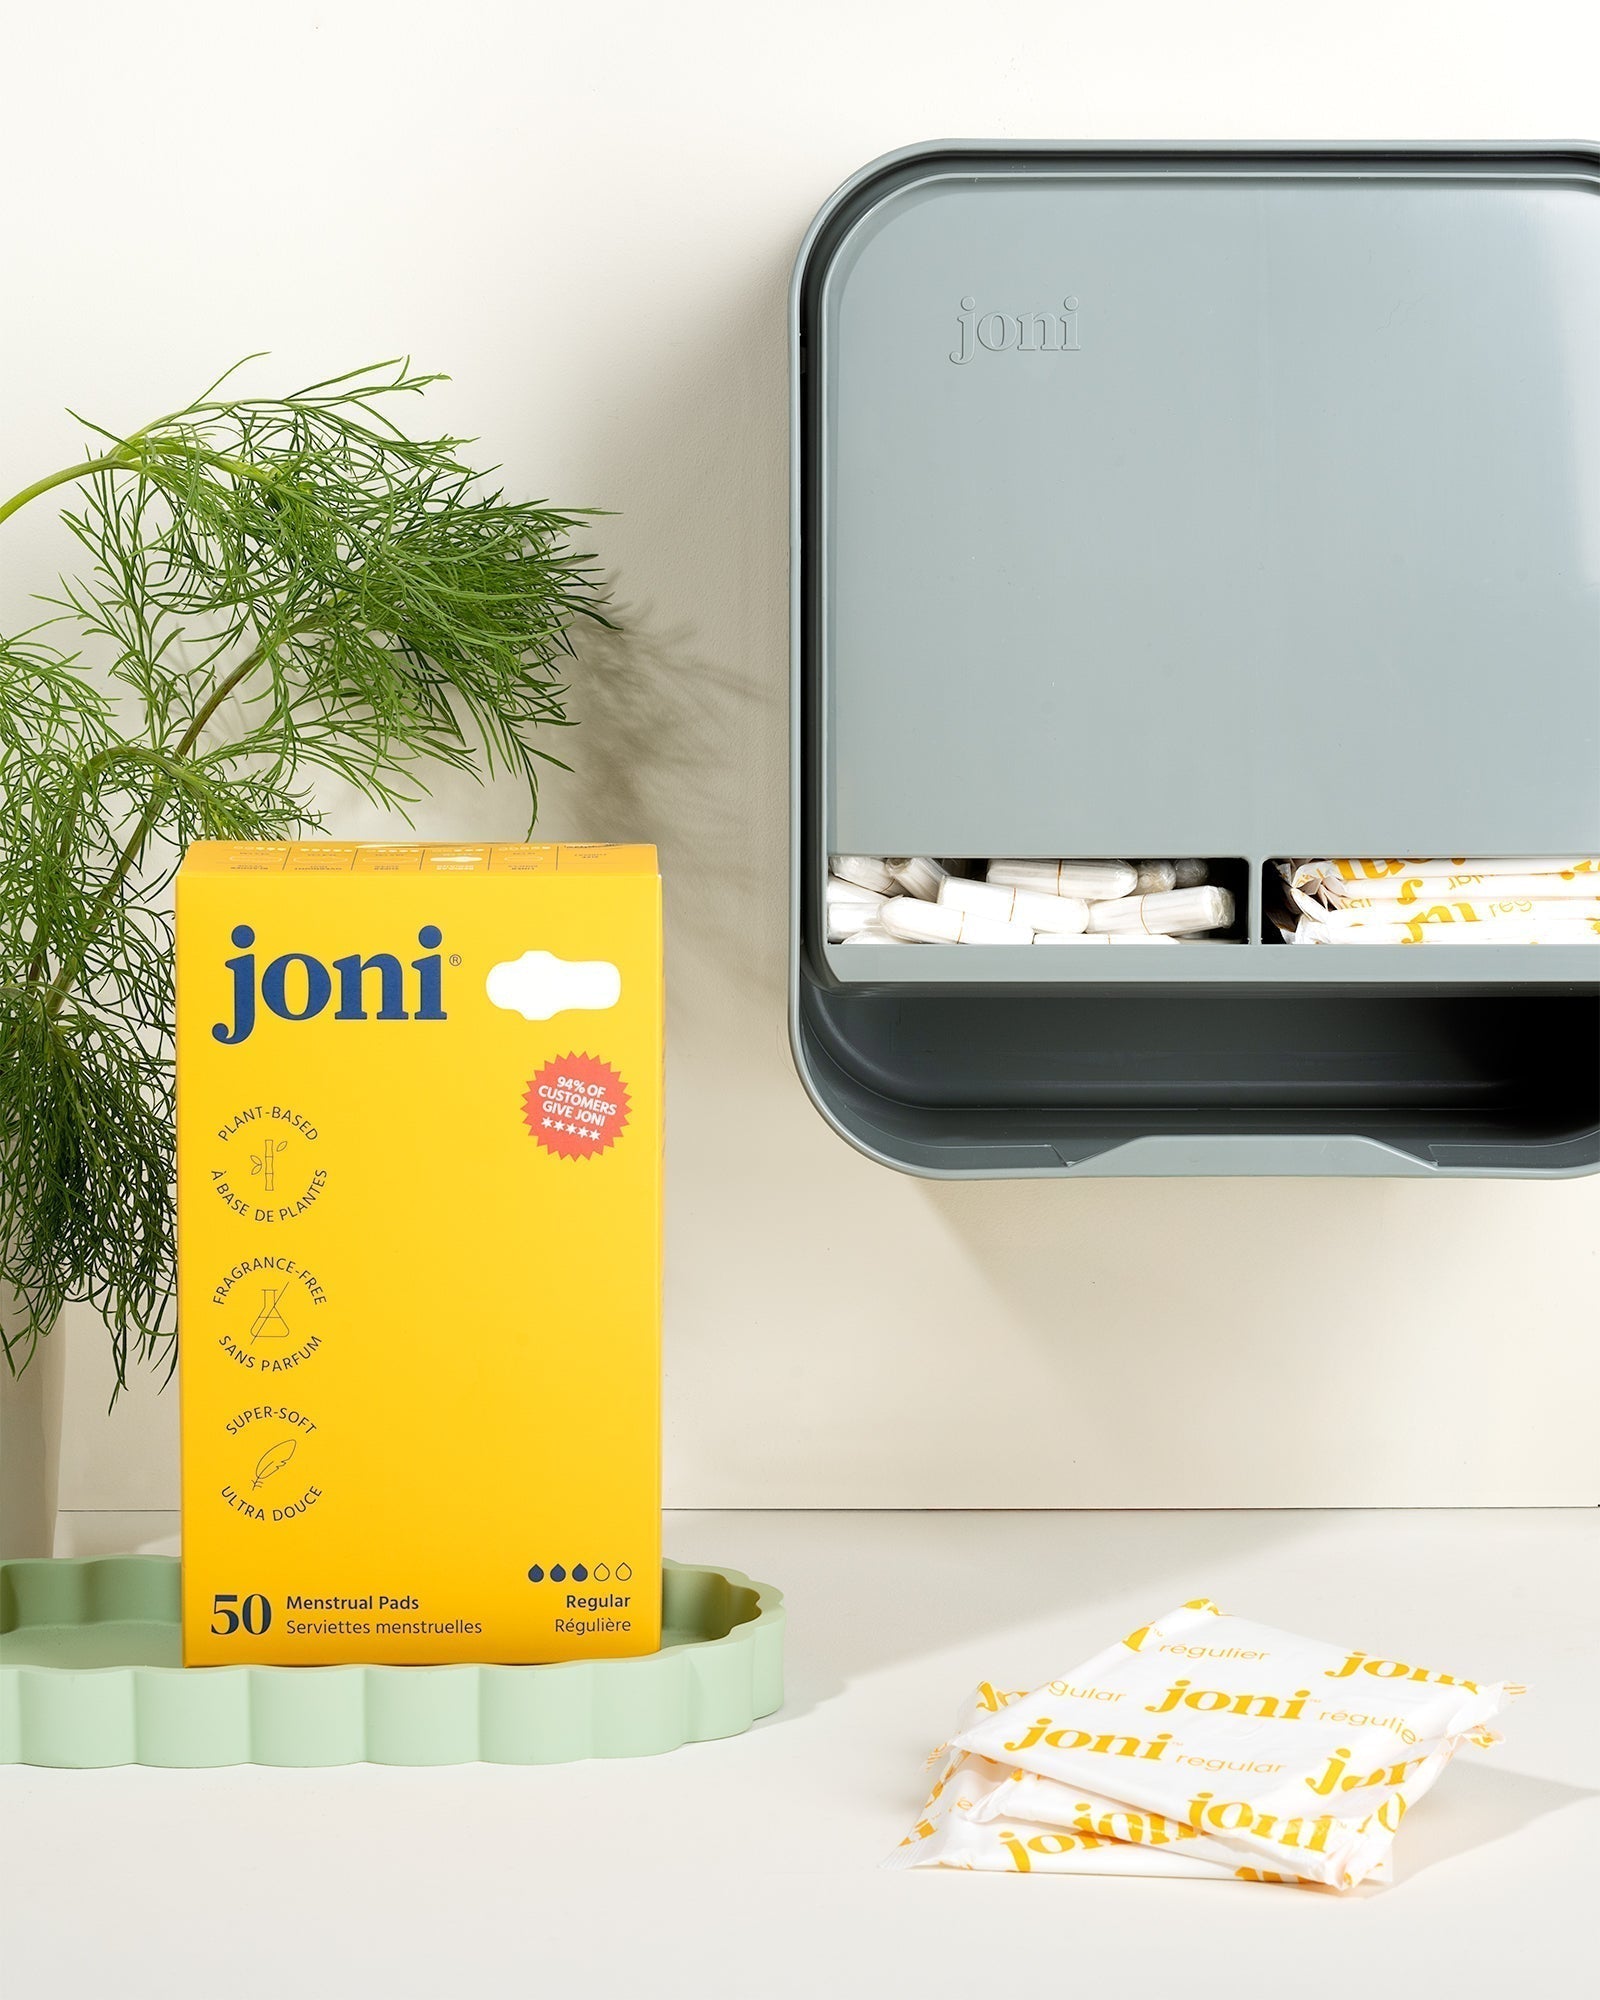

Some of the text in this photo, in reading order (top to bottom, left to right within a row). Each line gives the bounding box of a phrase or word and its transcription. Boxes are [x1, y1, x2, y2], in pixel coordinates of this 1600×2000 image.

[949, 296, 1081, 365] joni
[538, 1085, 618, 1116] CUSTOMERS
[557, 1076, 606, 1098] 94% OF
[217, 1106, 318, 1141] PLANT-BASED
[542, 1100, 606, 1127] GIVE JONI
[211, 1169, 327, 1222] À BASE DE PLANTES
[212, 1256, 327, 1305] FRAGRANCE-FREE
[219, 1335, 322, 1372] SANS PARFUM
[226, 1406, 317, 1435] SUPER-SOFT
[221, 1485, 322, 1522] ULTRA DOUCE
[211, 1593, 271, 1636] 50
[286, 1595, 419, 1610] Menstrual Pads
[566, 1594, 631, 1612] Regular
[286, 1619, 482, 1634] Serviettes menstruelles
[555, 1617, 631, 1636] Régulière
[1159, 1642, 1271, 1661] régulier
[1048, 1680, 1127, 1702] gular
[1319, 1709, 1424, 1745] régulie
[1176, 1755, 1287, 1773] regular
